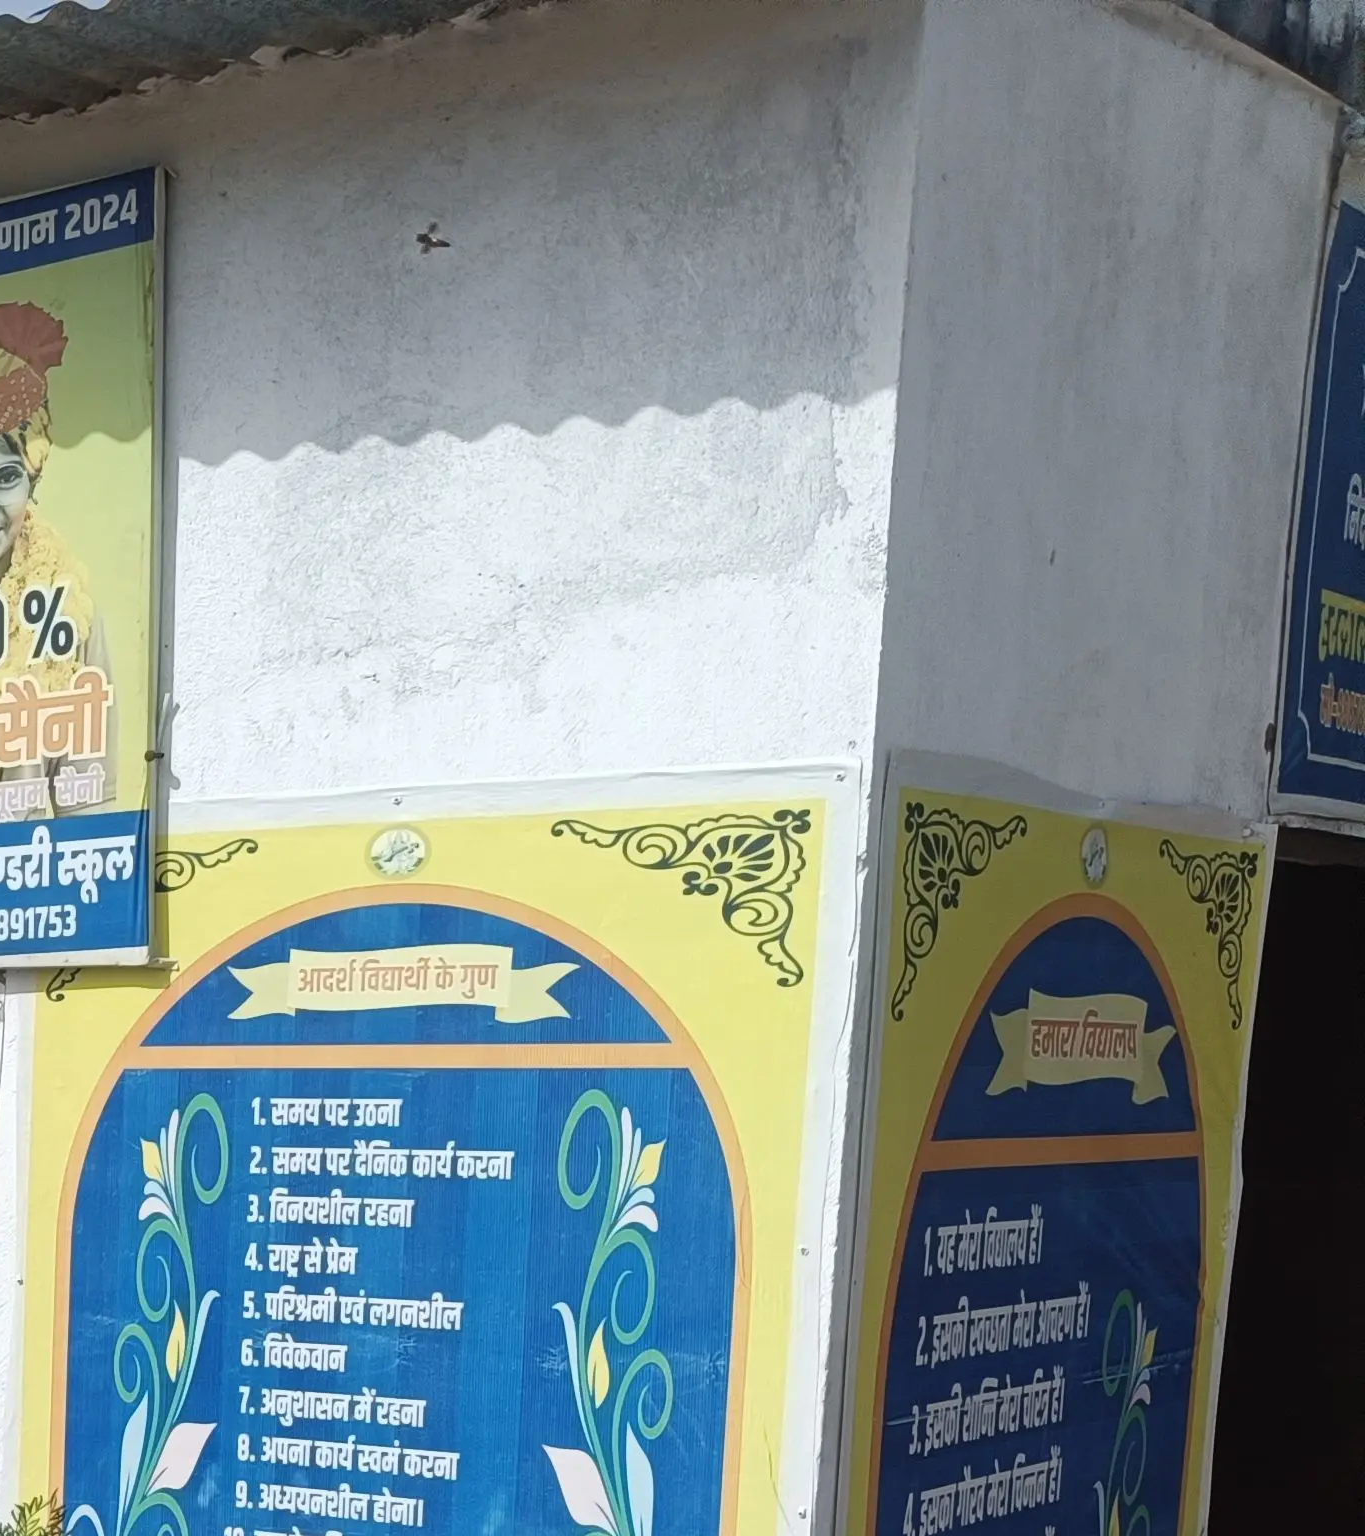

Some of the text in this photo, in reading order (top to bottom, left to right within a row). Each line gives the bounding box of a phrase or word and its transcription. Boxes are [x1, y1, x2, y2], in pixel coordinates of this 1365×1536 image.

[65, 187, 139, 239] 2024
[23, 580, 75, 661] %
[57, 832, 136, 901] स्कूल
[298, 957, 499, 998] आदर्श विद्यार्थी के गुण
[1031, 1009, 1137, 1061] हमारा विद्यालय
[252, 1097, 403, 1126] 1. समय पर उठना
[250, 1140, 514, 1179] 2. समय पर दैनिक कार्य करना
[247, 1188, 414, 1227] 3. विनयशील रहना
[245, 1237, 358, 1277] 4. राष्ट्र से प्रेम
[924, 1227, 932, 1276] 1.
[938, 1226, 957, 1273] यह
[958, 1209, 983, 1271] मेरा
[983, 1207, 1029, 1269] विद्यालय
[243, 1285, 464, 1330] 5. परिश्रमी एवं लगनशील
[241, 1333, 347, 1372] 6. विवेकवान
[239, 1386, 426, 1427] 7. अनुशासन में रहना
[238, 1434, 255, 1461] 8.
[261, 1437, 313, 1466] अपना
[314, 1435, 355, 1470] कार्य
[403, 1449, 460, 1480] करना
[236, 1481, 253, 1508] 9.
[259, 1483, 370, 1520] अध्ययनशील
